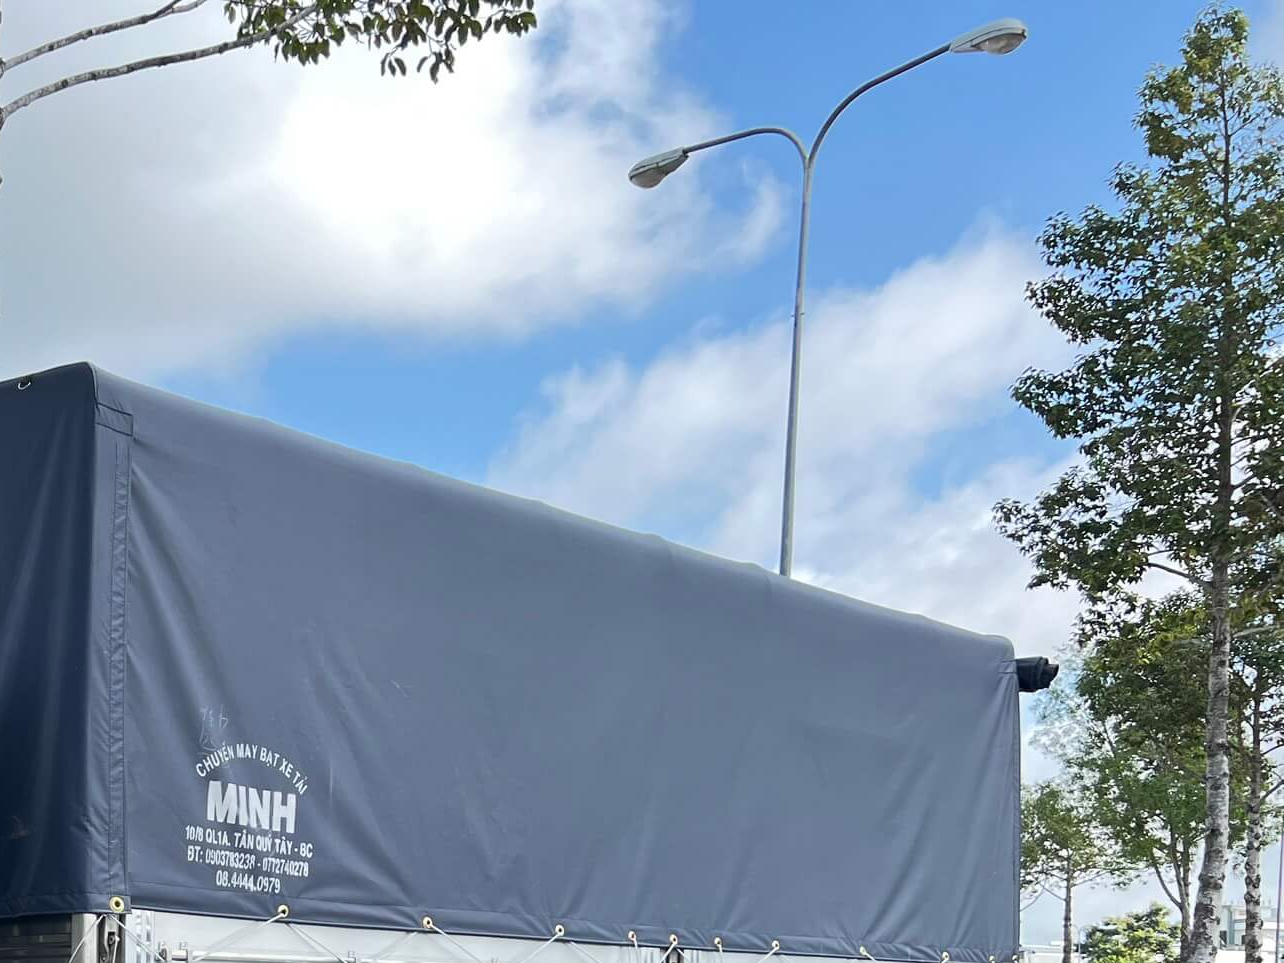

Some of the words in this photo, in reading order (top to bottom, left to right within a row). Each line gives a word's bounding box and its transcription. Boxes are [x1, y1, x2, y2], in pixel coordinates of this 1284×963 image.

[236, 743, 258, 760] MAY
[259, 747, 280, 768] BẠT
[279, 758, 294, 778] XE
[207, 780, 297, 834] MINH
[187, 845, 204, 864] ĐT:
[234, 828, 254, 850] TÂN
[299, 842, 314, 858] BC
